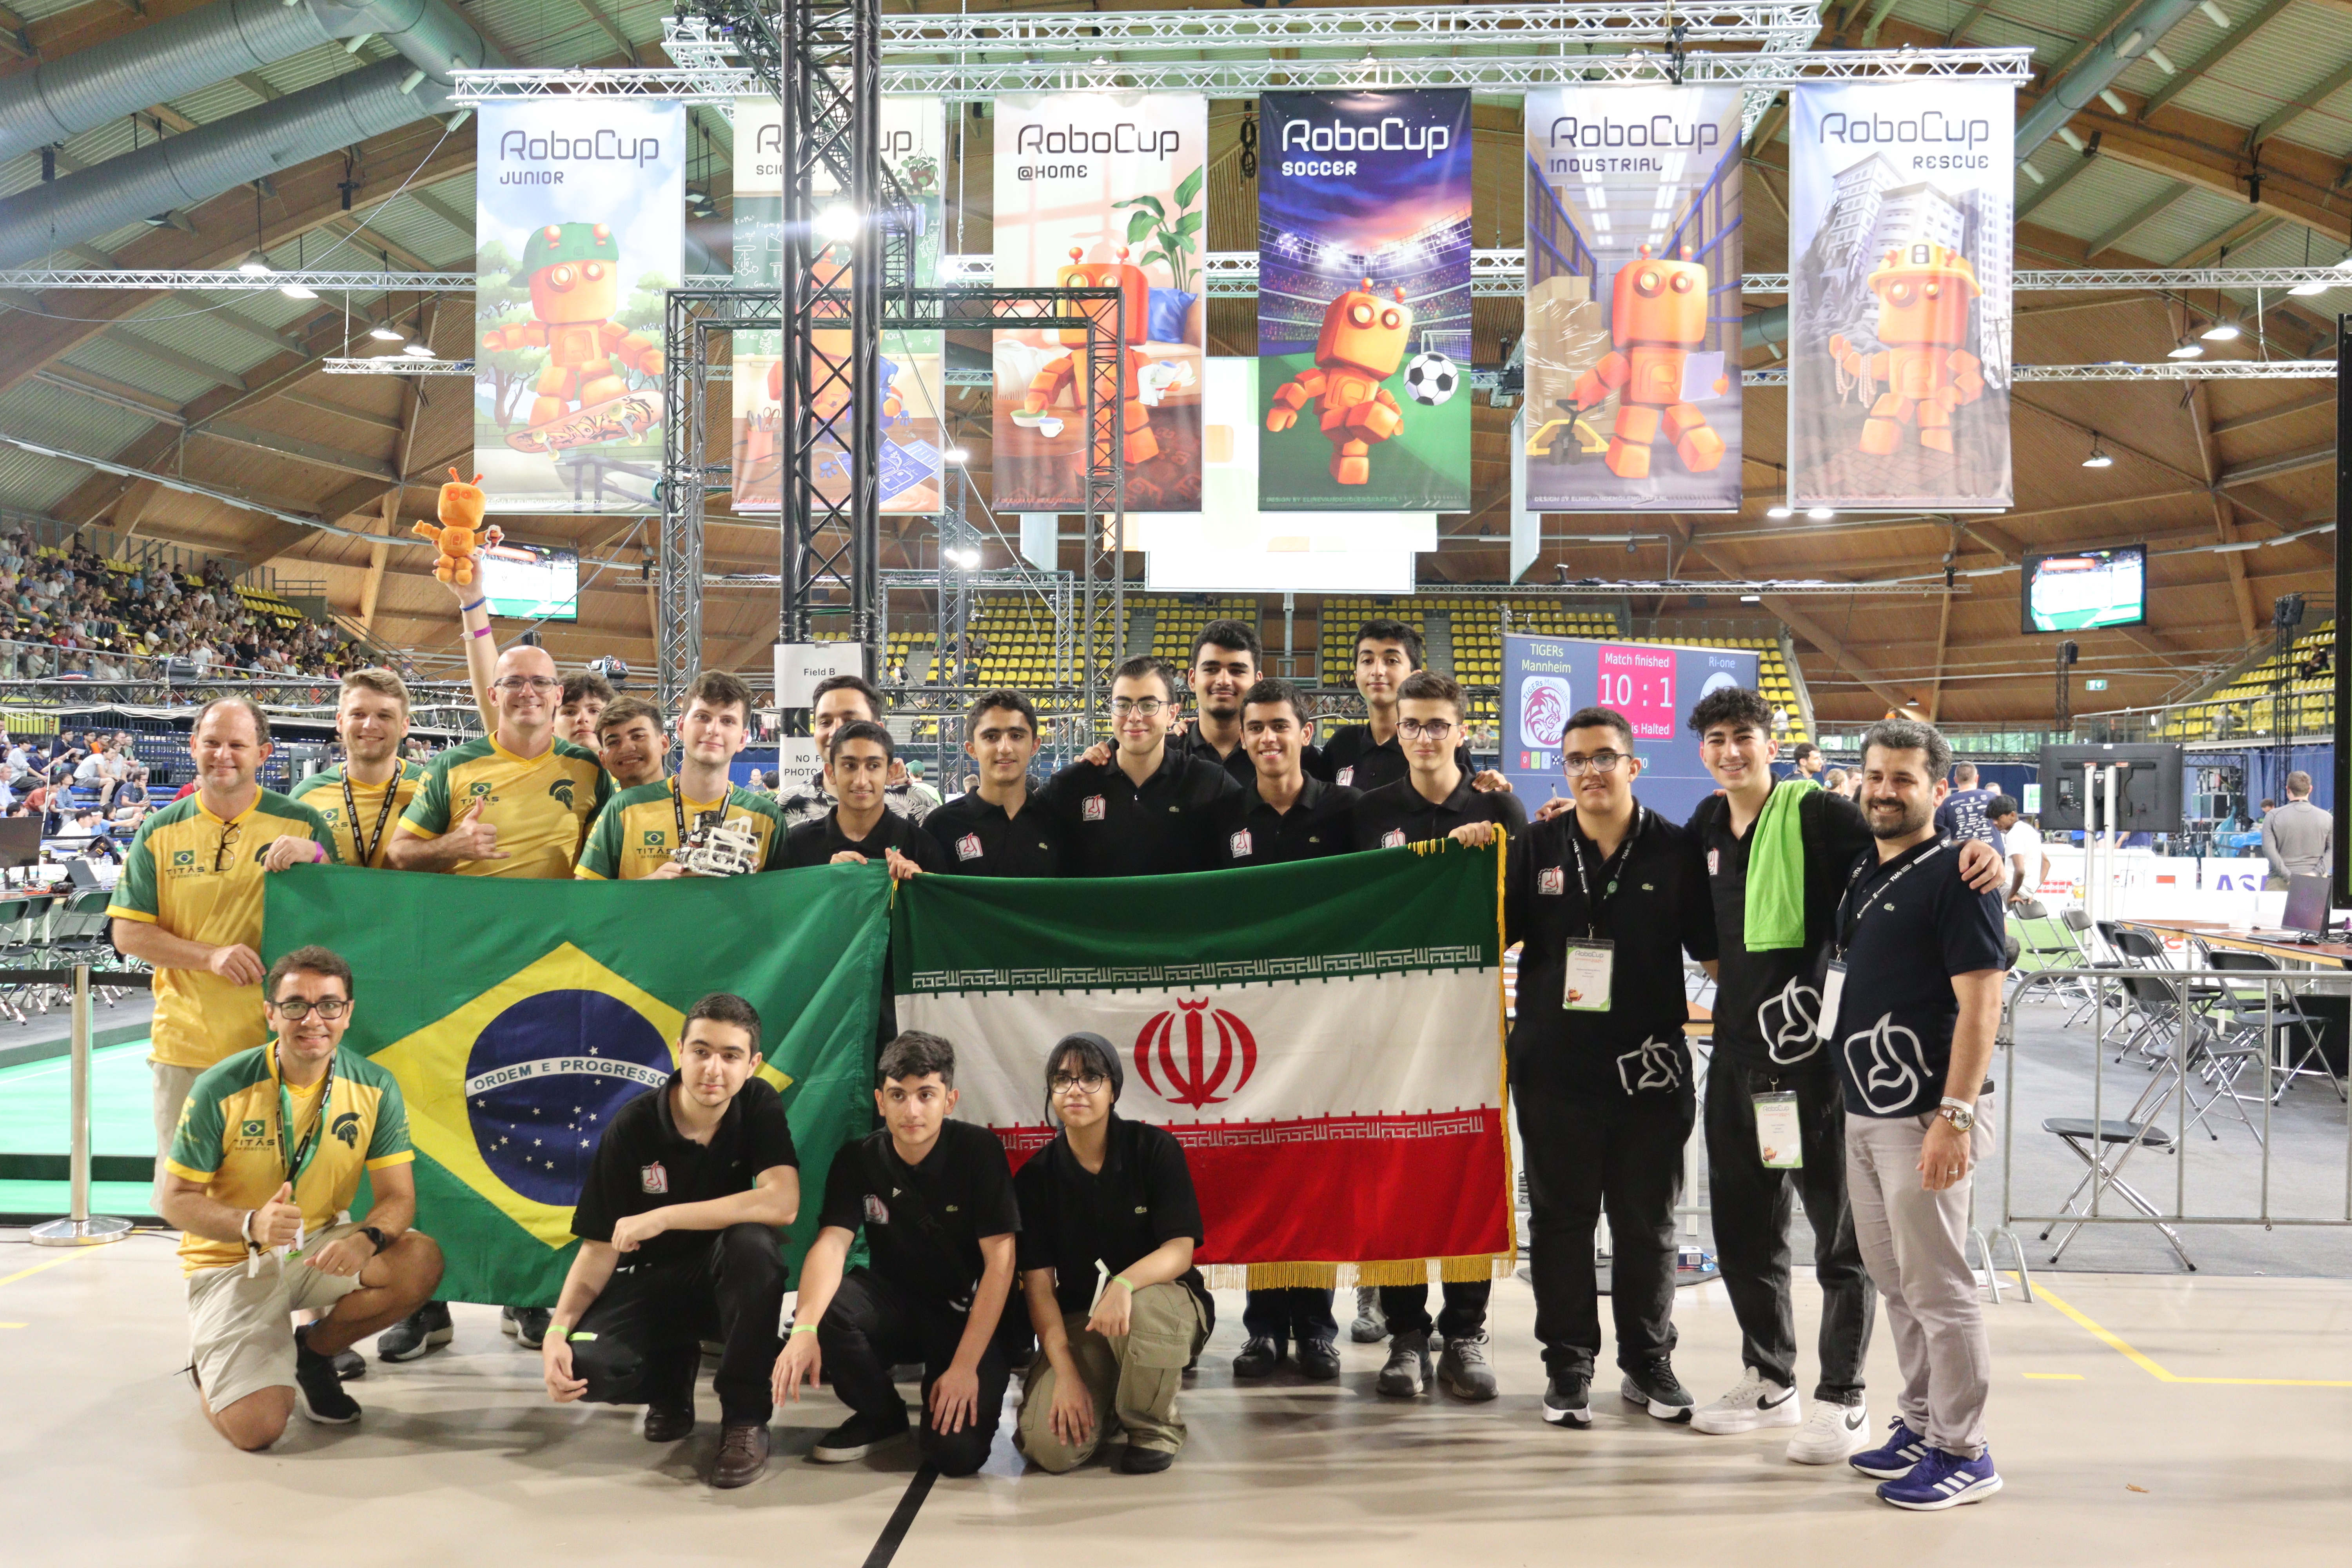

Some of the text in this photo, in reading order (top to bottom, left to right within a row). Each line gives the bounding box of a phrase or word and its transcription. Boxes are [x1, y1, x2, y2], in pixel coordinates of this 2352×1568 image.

[1551, 115, 1718, 154] RoboCup
[1820, 111, 1989, 150] RoboCup
[1018, 123, 1179, 161] RoboCup
[1282, 118, 1449, 158] RoboCup
[501, 129, 659, 168] RoboCup
[1281, 161, 1357, 176] SOCCER
[1551, 158, 1662, 172] INDUSTRIAL
[1913, 155, 1989, 169] RESCUE
[500, 171, 564, 185] JUNIOR
[1018, 165, 1087, 181] @HOME
[1530, 644, 1563, 657] TIGERs
[1522, 659, 1571, 673] Mannheim
[1605, 653, 1670, 667] Match finished
[1709, 656, 1735, 668] Ri-one
[1601, 674, 1632, 706] 10
[1660, 677, 1672, 707] 1
[1641, 723, 1670, 735] Halted
[1889, 871, 1902, 882] TU/e
[474, 1064, 532, 1090] ORDEM
[542, 1062, 550, 1072] E
